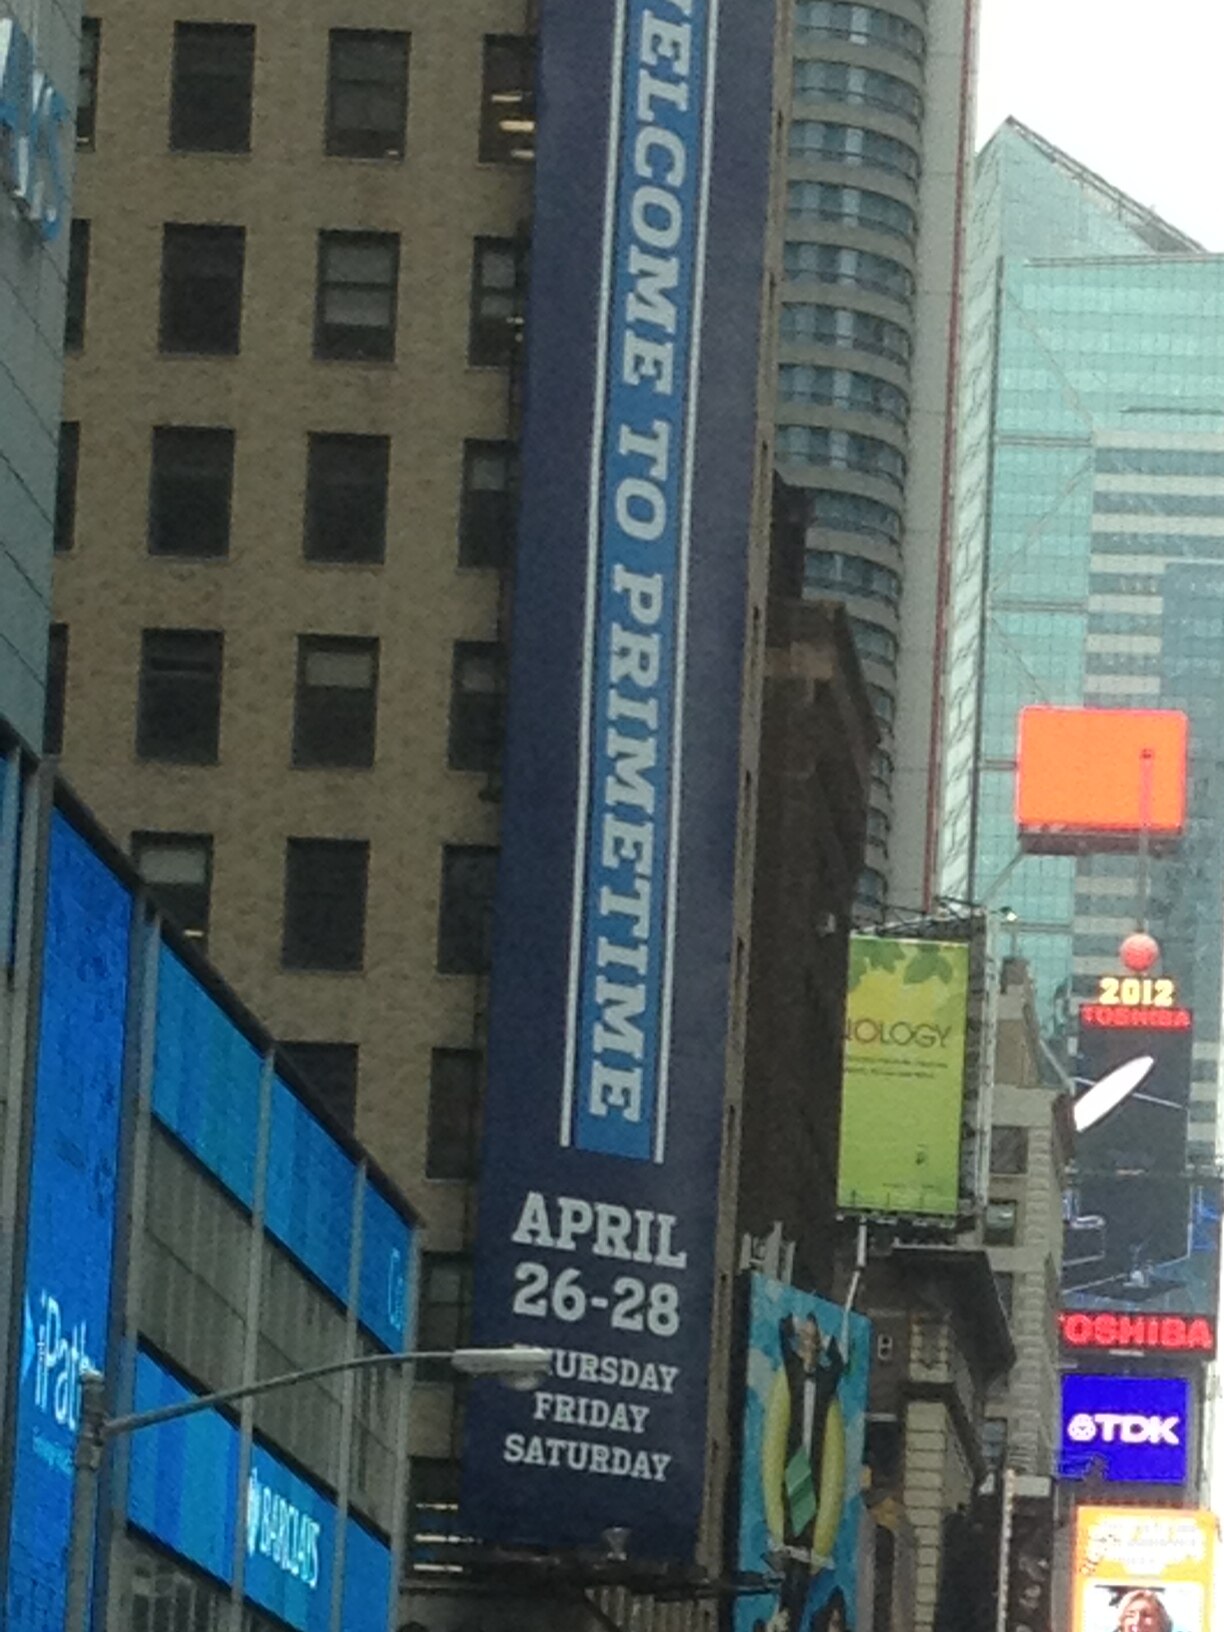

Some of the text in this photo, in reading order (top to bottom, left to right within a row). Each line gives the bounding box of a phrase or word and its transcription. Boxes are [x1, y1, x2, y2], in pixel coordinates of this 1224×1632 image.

[588, 0, 696, 1124] ELCOME TO PRIMETIME
[1100, 978, 1175, 1007] 2012
[511, 1191, 689, 1270] APRIL
[511, 1262, 682, 1337] 26-28
[1058, 1313, 1213, 1350] OSHIBA
[545, 1349, 679, 1395] URSDAY
[532, 1391, 650, 1434] FRIDAY
[1102, 1412, 1180, 1446] TDK
[503, 1432, 673, 1483] SATURDAY
